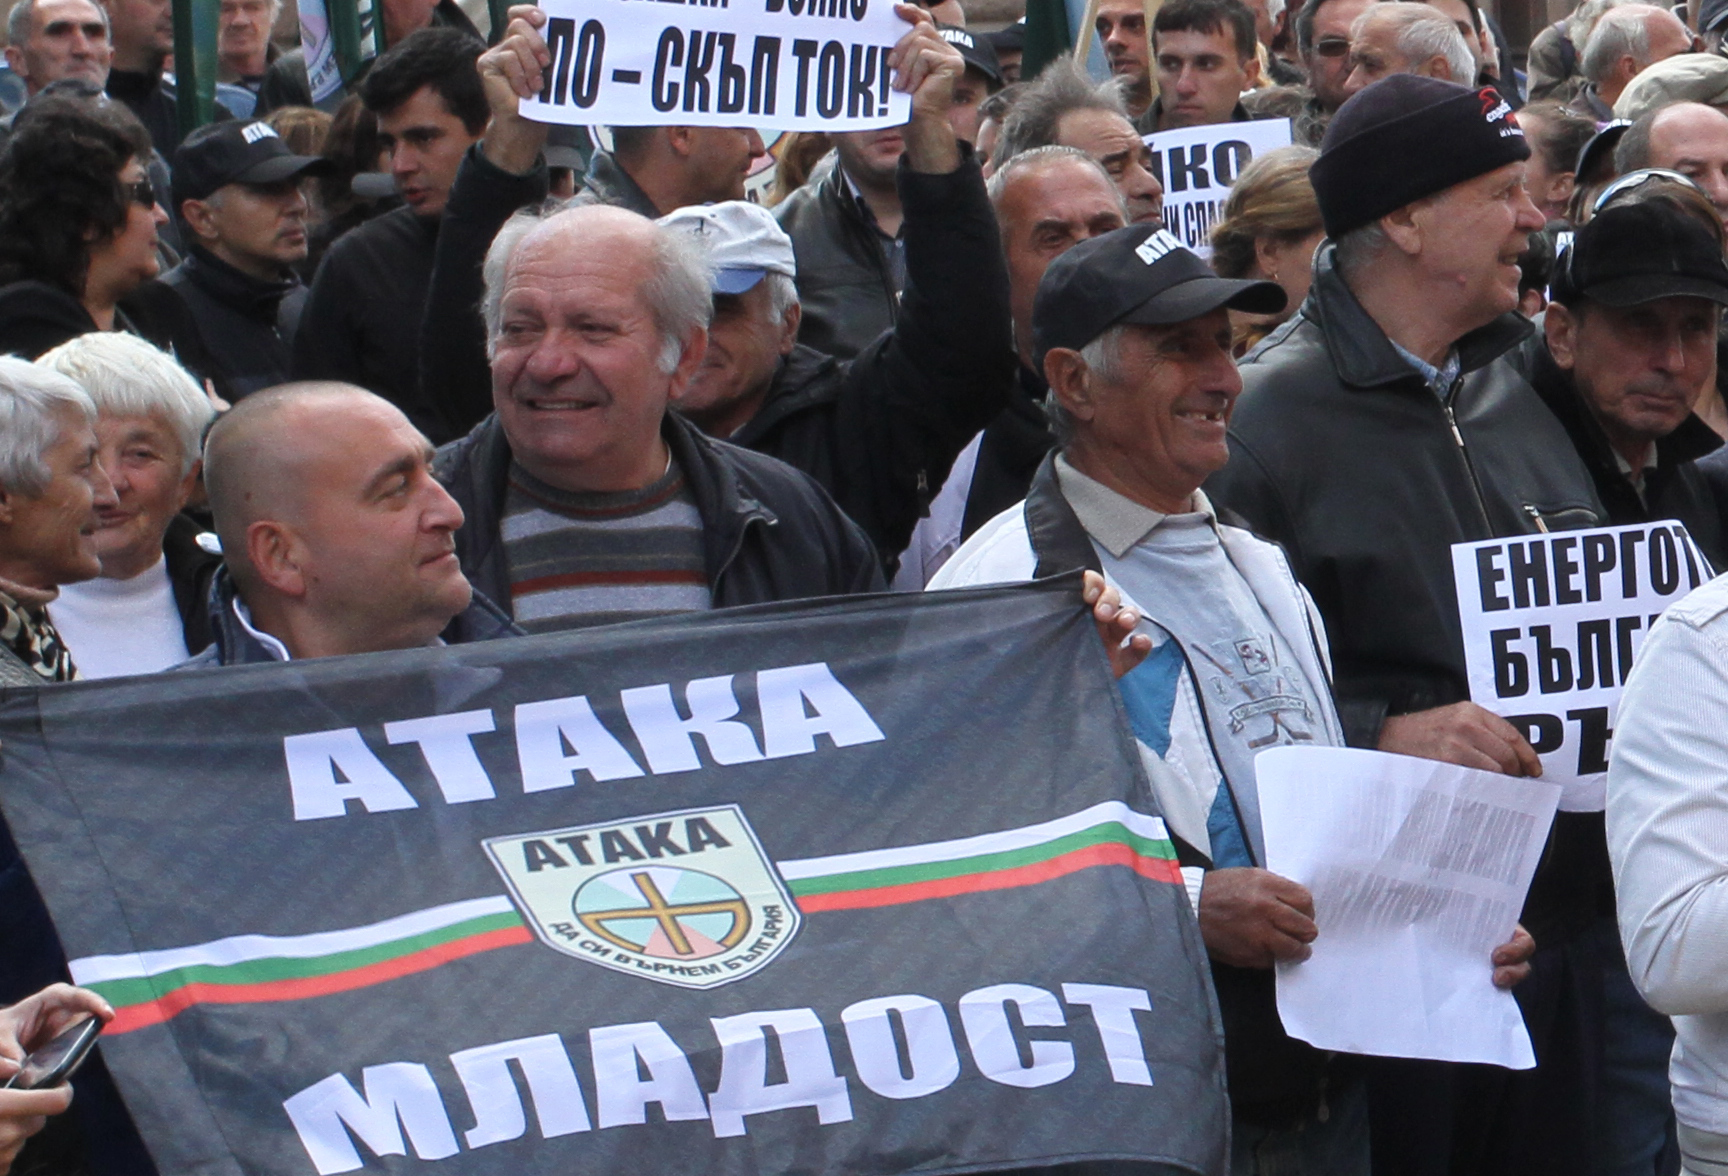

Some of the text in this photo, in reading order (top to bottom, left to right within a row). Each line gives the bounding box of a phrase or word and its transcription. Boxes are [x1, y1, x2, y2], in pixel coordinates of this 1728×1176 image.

[539, 16, 606, 109] ПО
[651, 26, 782, 116] СКЪП
[792, 38, 897, 120] ТОК!
[1476, 525, 1716, 613] ЕНЕРГОТ
[283, 662, 885, 821] АТАКА
[522, 817, 733, 872] АТАКА
[551, 904, 781, 977] ДА СИ ВЪРНЕМ БЪЛГАРИЯ
[283, 982, 1154, 1175] МЛАДОСТ
